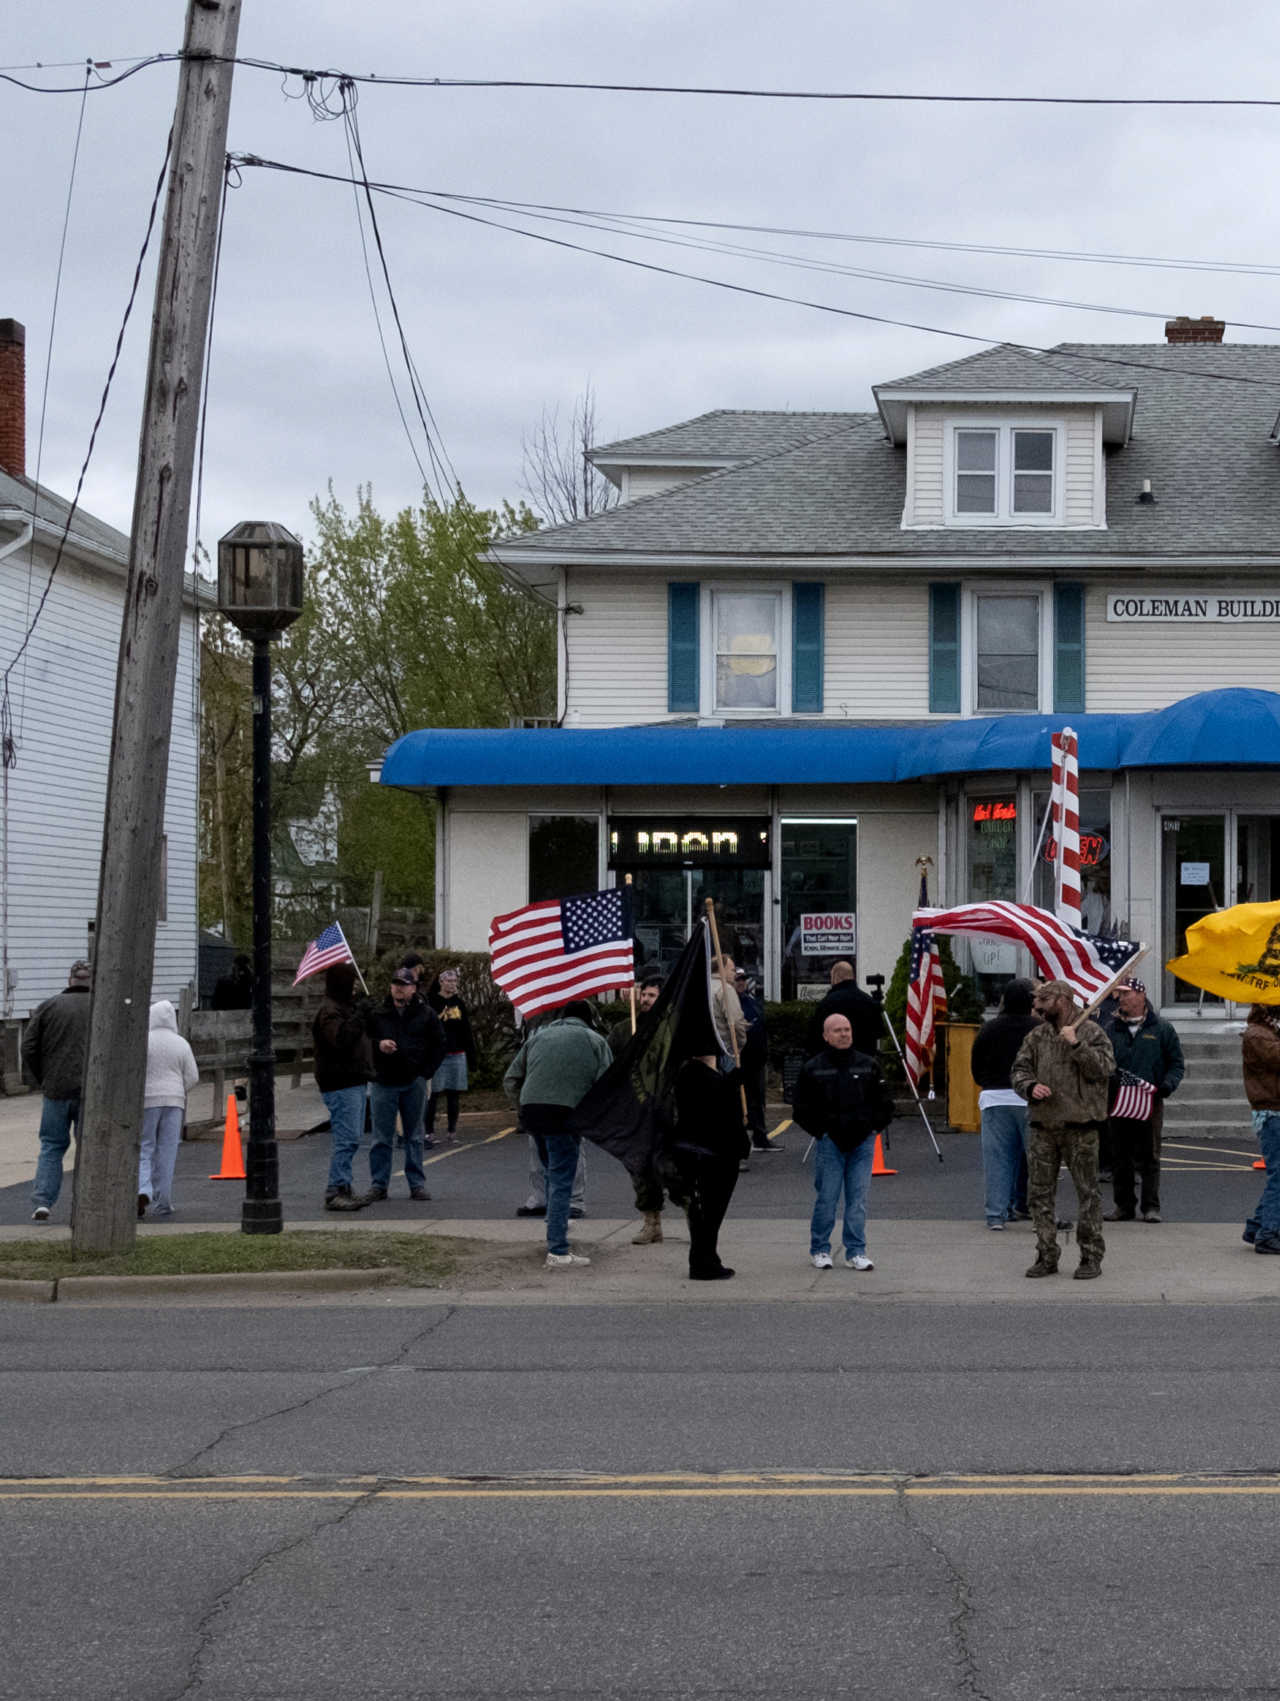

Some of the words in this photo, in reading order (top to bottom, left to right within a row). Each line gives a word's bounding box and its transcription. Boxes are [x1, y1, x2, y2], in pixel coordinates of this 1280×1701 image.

[1113, 599, 1208, 617] COLEMAN
[1045, 835, 1103, 864] OEN
[803, 915, 853, 931] BOOKS
